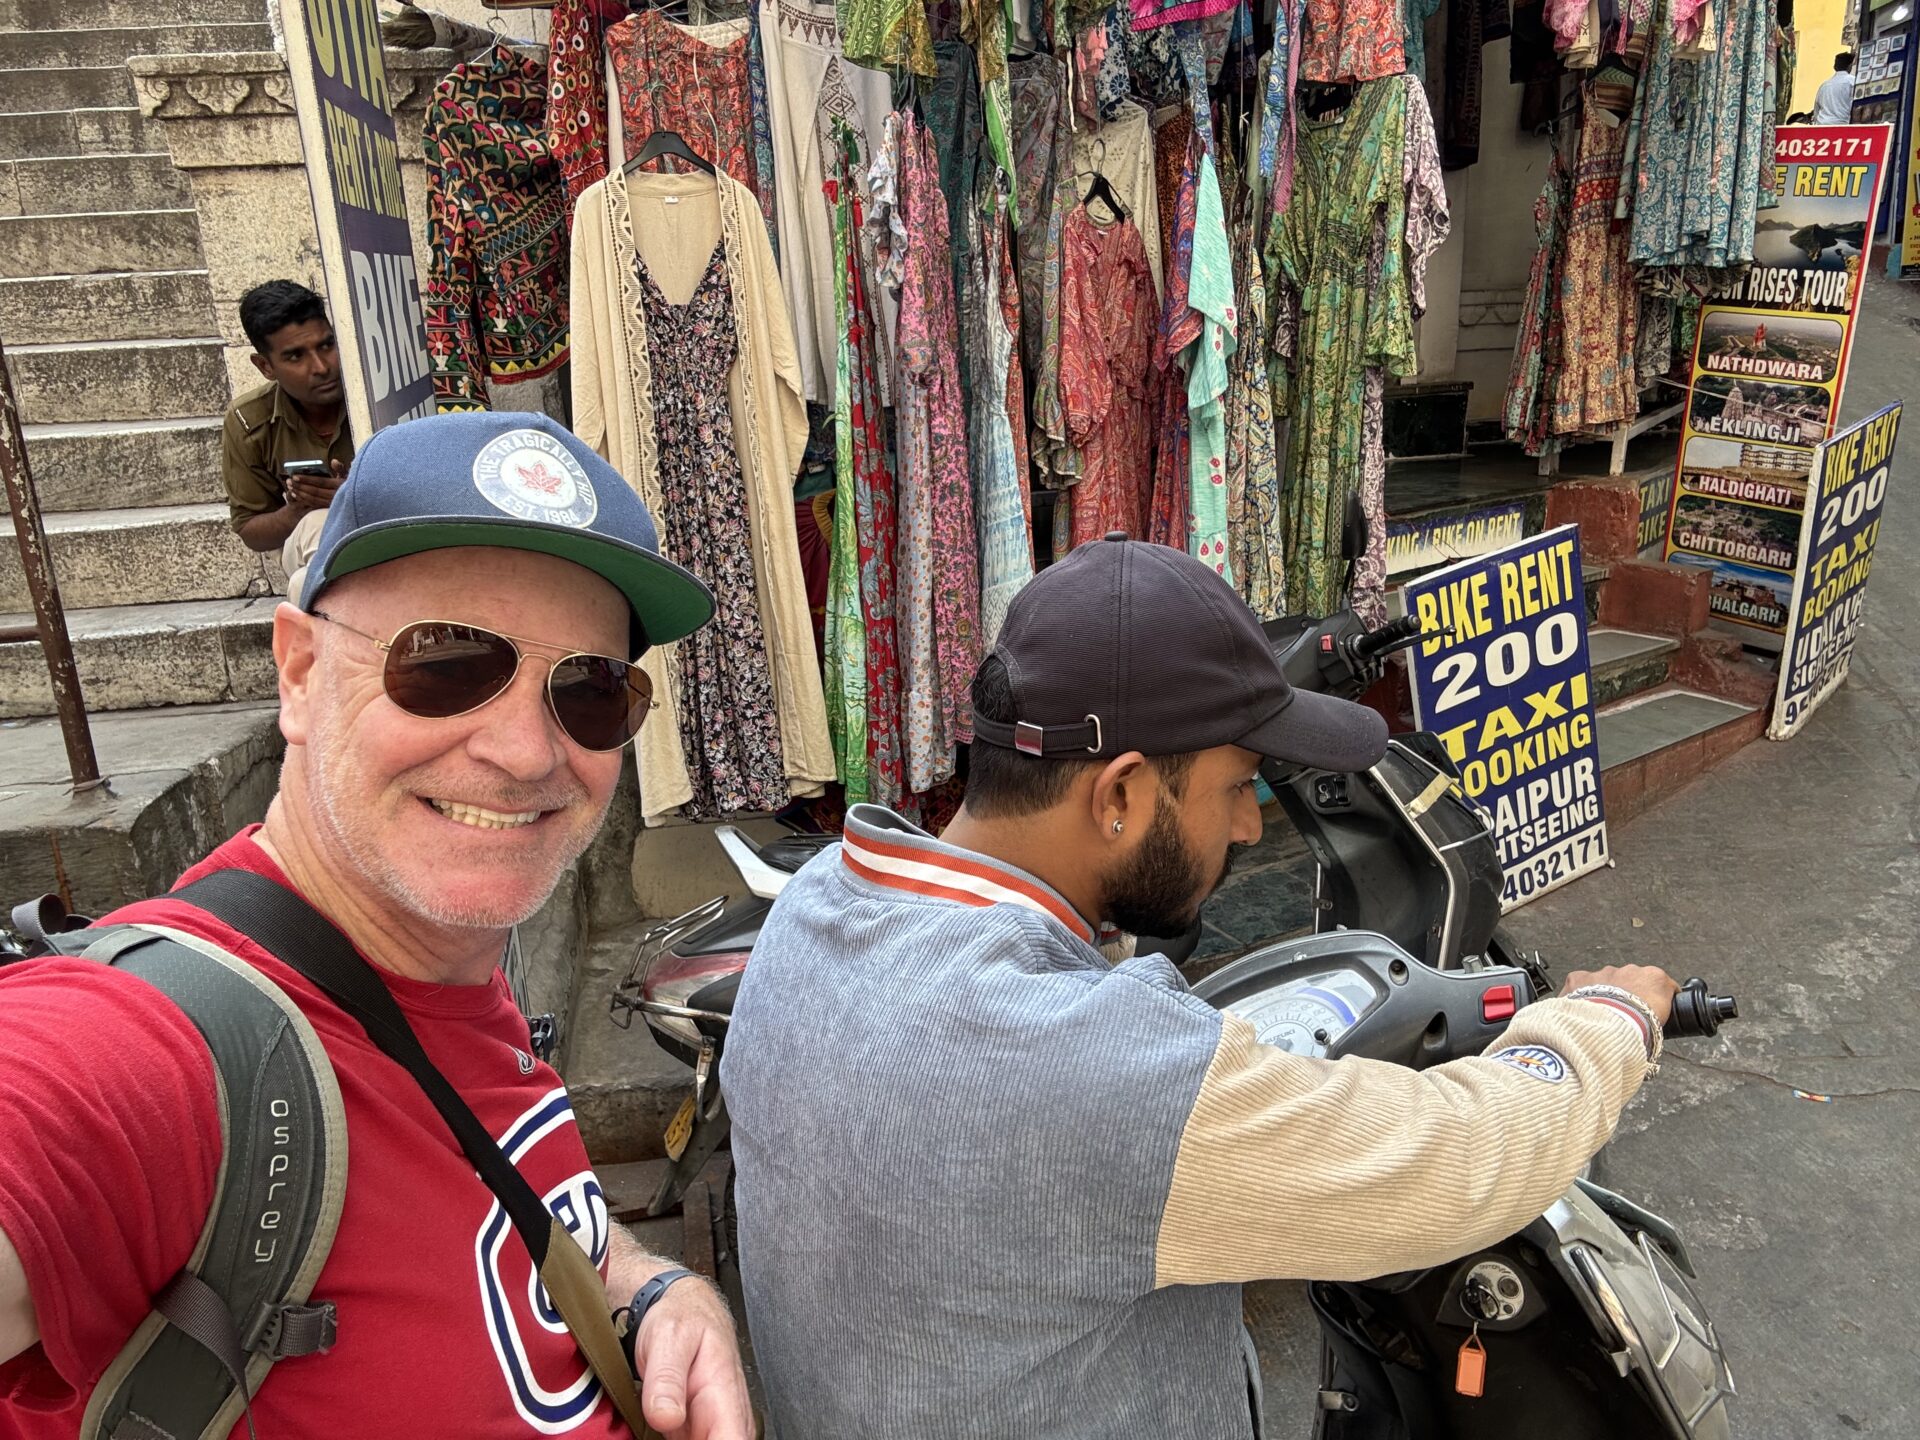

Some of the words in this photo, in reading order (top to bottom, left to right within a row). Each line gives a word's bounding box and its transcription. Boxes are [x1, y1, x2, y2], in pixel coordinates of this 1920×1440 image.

[324, 98, 370, 210] RENT
[364, 122, 383, 216] &
[374, 130, 408, 220] RIDE
[1775, 138, 1872, 156] 4032171
[1793, 165, 1869, 197] RENT
[1748, 267, 1798, 304] RISES
[1801, 269, 1849, 307] TOUR
[351, 250, 431, 403] BIKE
[1707, 354, 1823, 380] NATHDWARA
[1710, 416, 1801, 443] EKLINGJI
[1823, 430, 1862, 498] BIKE
[1860, 406, 1901, 474] RENT
[480, 455, 500, 481] THE
[493, 434, 584, 477] TRAGICALLY
[577, 481, 592, 506] HIP
[1640, 477, 1670, 514] TAXI
[1699, 475, 1792, 506] HALDIGHATI
[501, 497, 538, 520] EST.
[544, 508, 580, 525] 1984
[1386, 532, 1419, 559] KING
[1432, 523, 1464, 547] BIKE
[1465, 520, 1485, 545] ON
[1488, 512, 1520, 541] RENT
[1637, 510, 1667, 549] BIKE
[1818, 466, 1888, 547] 200
[1679, 532, 1792, 567] CHITTORGARH
[1811, 517, 1881, 589] TAXI
[1416, 571, 1493, 657] BIKE
[1499, 539, 1574, 625] RENT
[1802, 553, 1872, 629] BOOKING
[1431, 612, 1579, 714] 200
[1795, 586, 1865, 669] UDAIPUR
[1438, 672, 1588, 763] TAXI
[1502, 828, 1604, 902] 4032171
